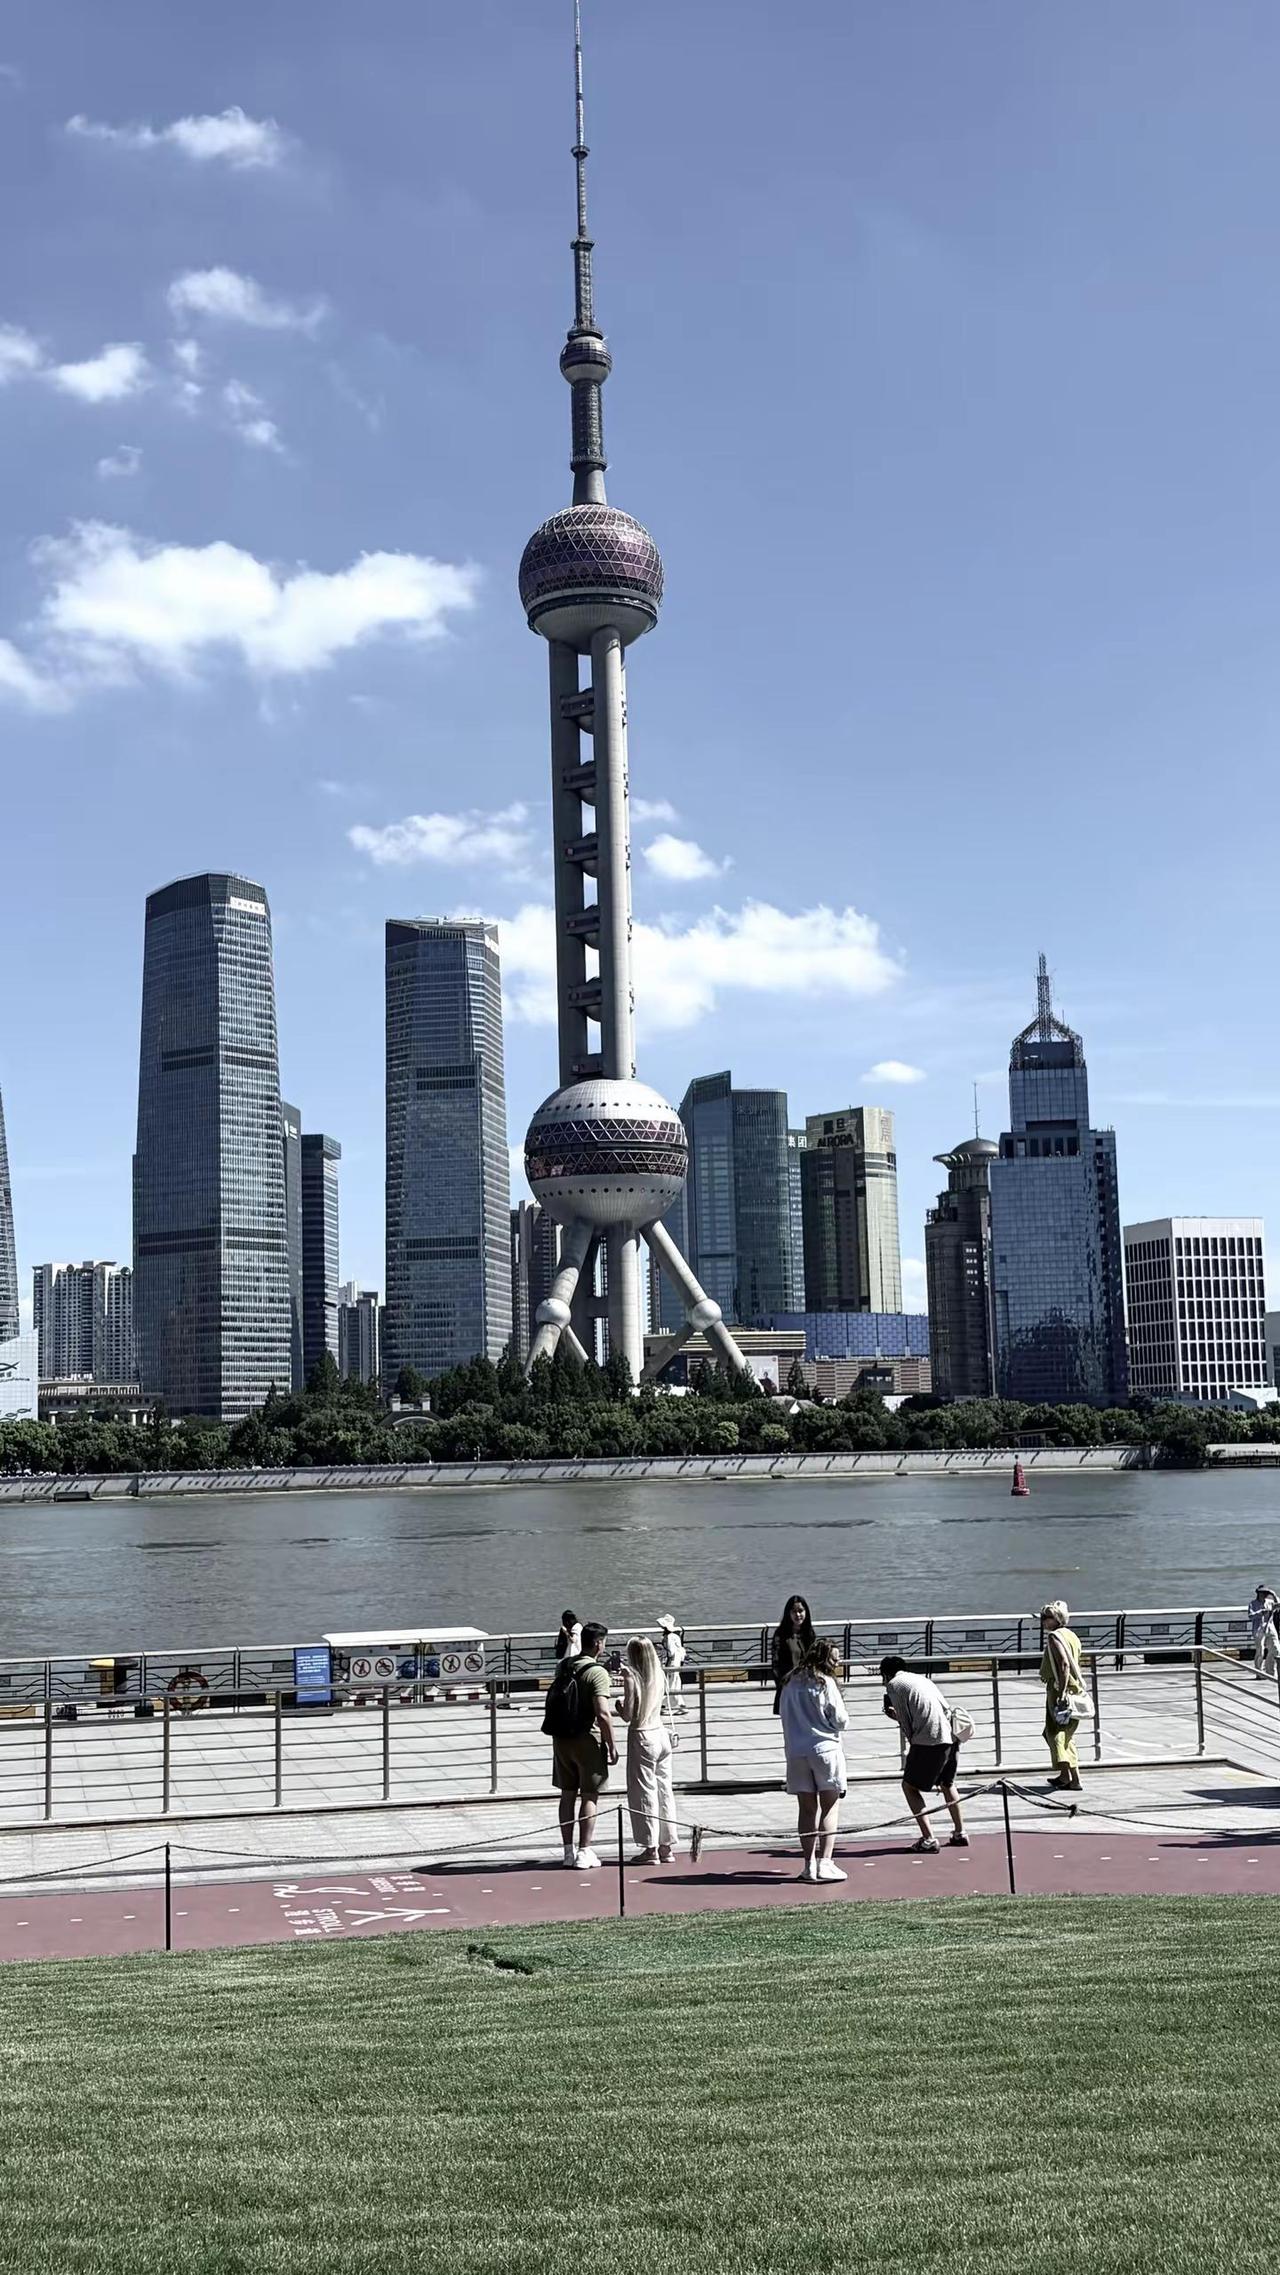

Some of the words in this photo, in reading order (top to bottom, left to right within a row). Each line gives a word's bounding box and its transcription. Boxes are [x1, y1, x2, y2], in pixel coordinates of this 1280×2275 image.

[788, 1135, 807, 1148] 集团
[817, 1133, 854, 1147] AURORA
[312, 1908, 345, 1933] STROLL
